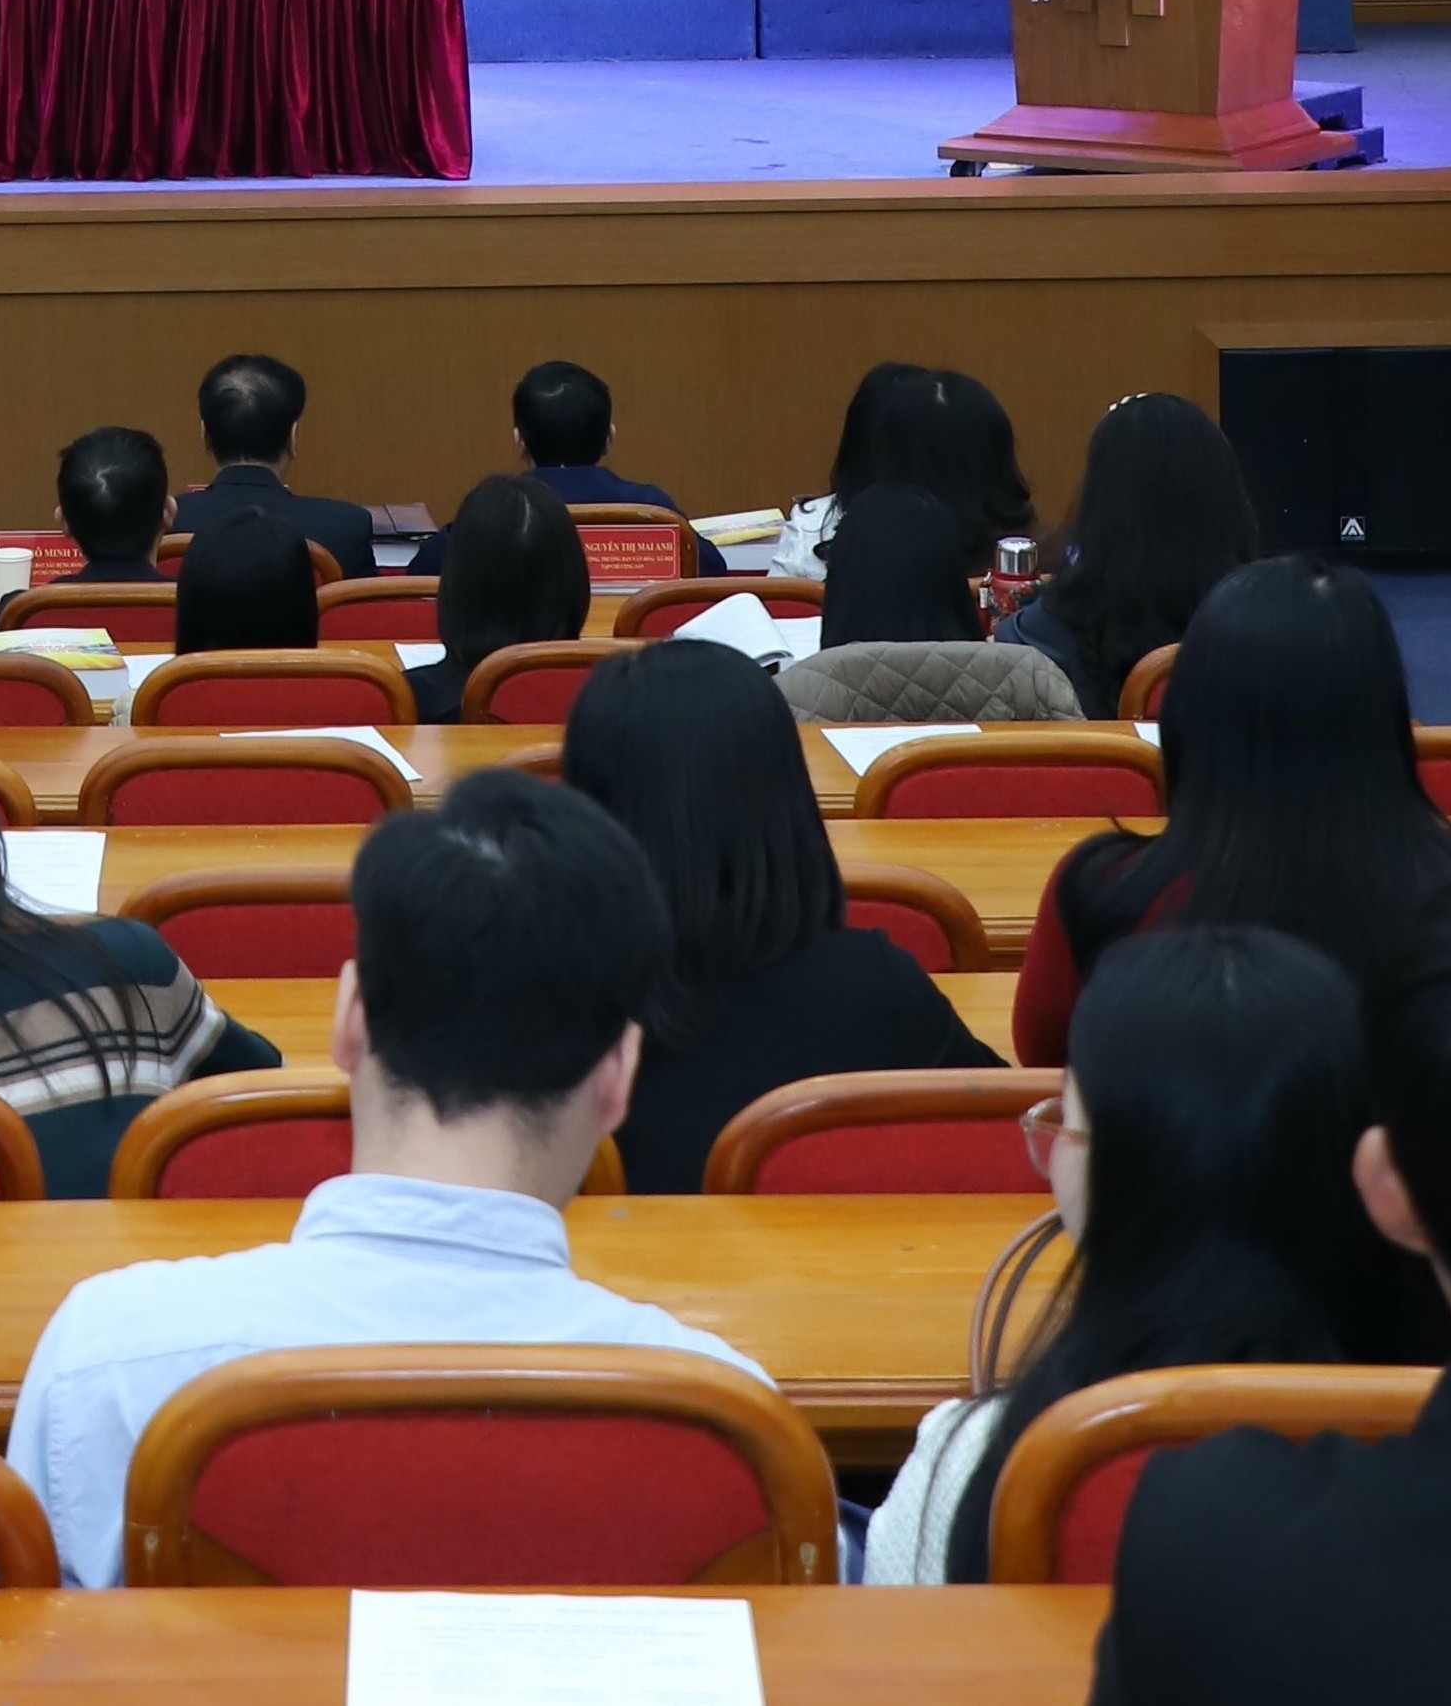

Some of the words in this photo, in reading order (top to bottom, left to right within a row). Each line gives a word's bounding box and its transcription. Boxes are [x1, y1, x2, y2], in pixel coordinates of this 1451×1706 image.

[637, 543, 653, 551] MAI
[656, 543, 673, 551] ANH
[44, 548, 71, 557] MINH
